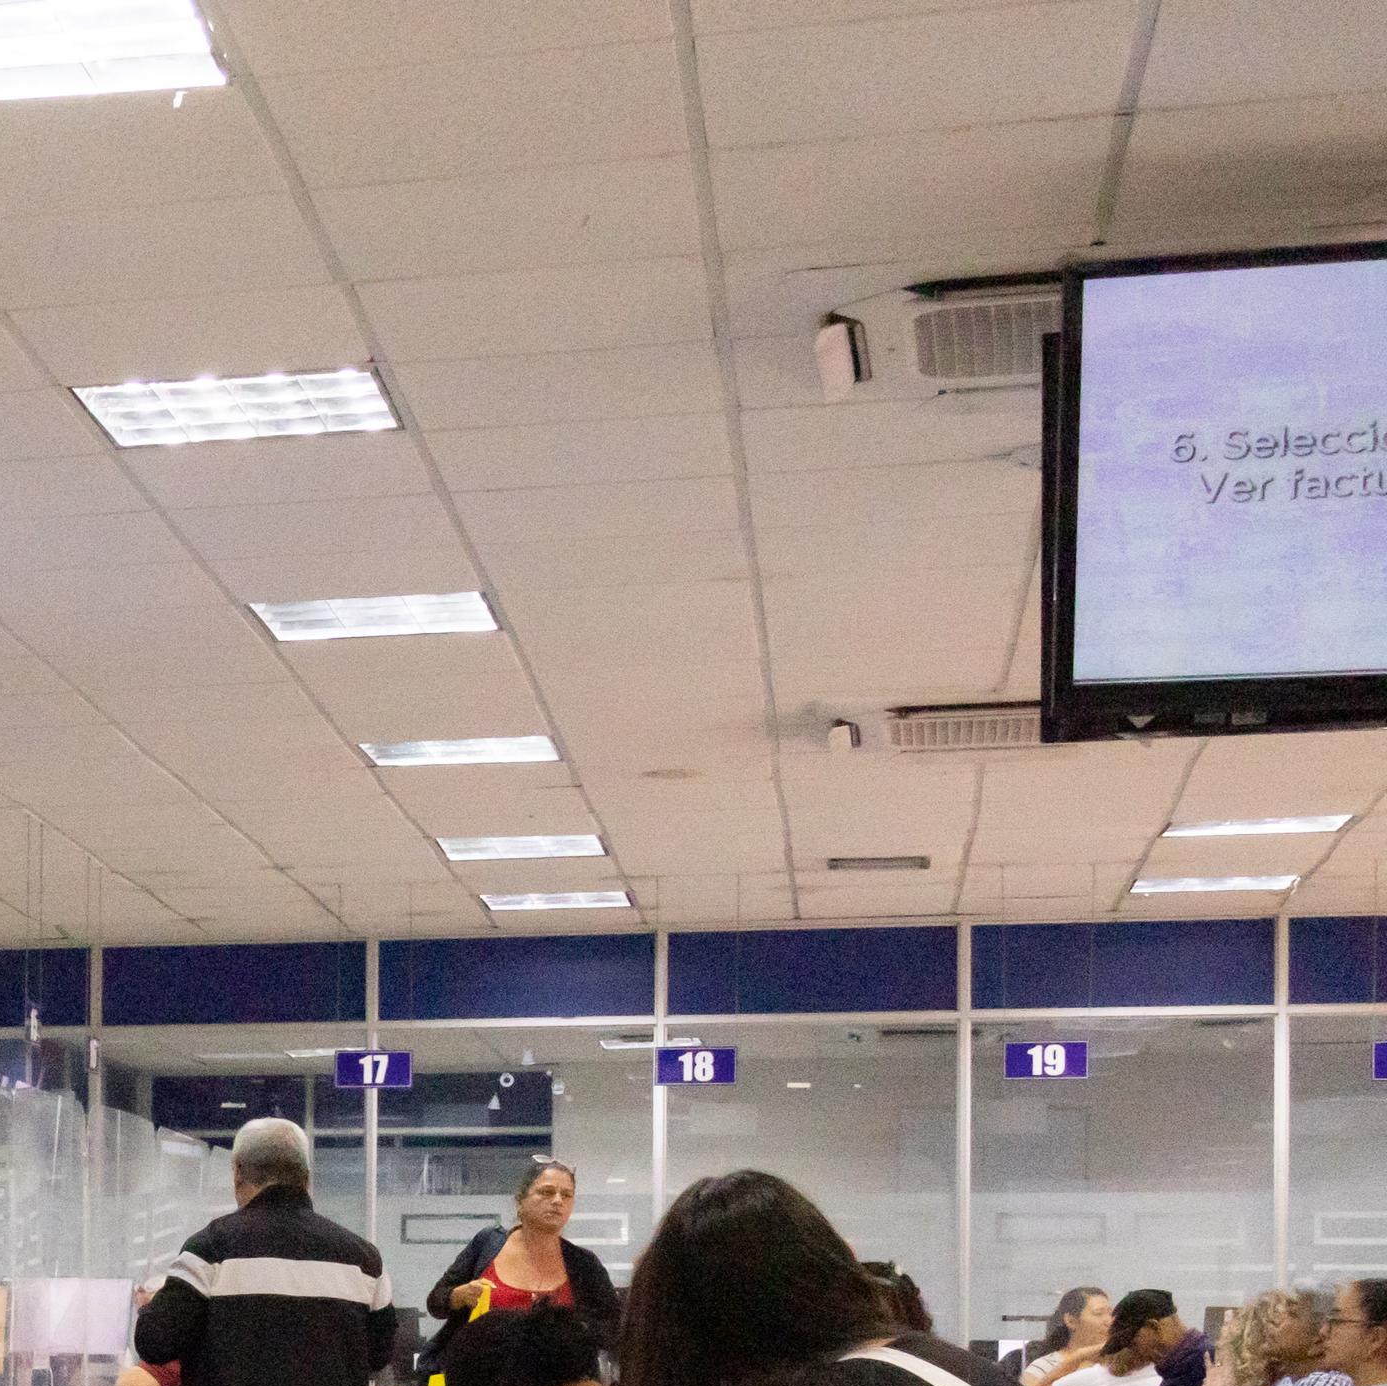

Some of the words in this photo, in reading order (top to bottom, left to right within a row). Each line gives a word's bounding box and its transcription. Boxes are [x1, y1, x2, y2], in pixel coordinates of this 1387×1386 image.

[1172, 432, 1209, 463] 6.
[1224, 420, 1387, 461] Selecci
[1200, 472, 1274, 504] Ver
[358, 1054, 389, 1084] 17
[678, 1051, 715, 1082] 18
[1027, 1044, 1066, 1076] 19
